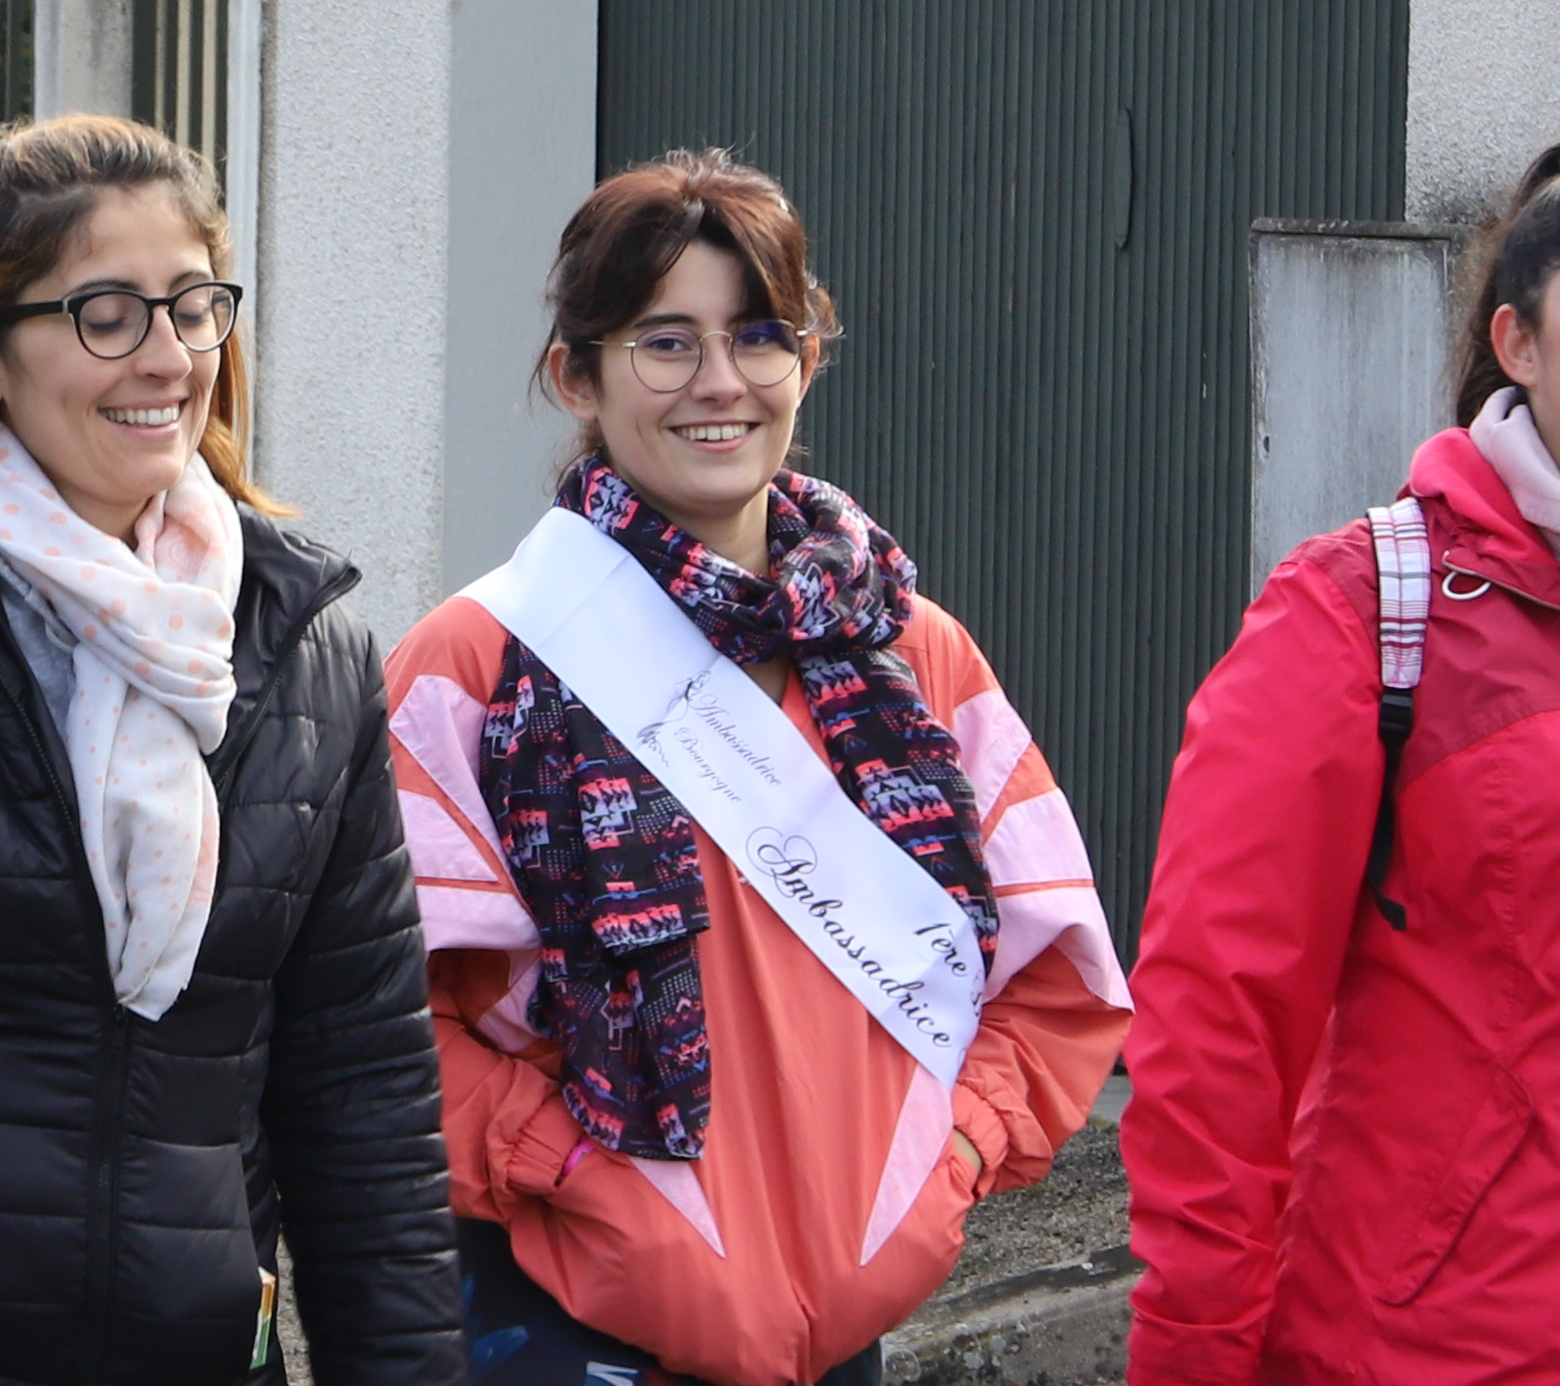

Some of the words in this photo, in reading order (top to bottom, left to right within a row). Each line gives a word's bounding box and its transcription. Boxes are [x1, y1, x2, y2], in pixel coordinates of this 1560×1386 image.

[673, 726, 742, 803] Bourgogne
[688, 694, 781, 786] Ambassadrice
[745, 826, 953, 1049] Ambassadrice
